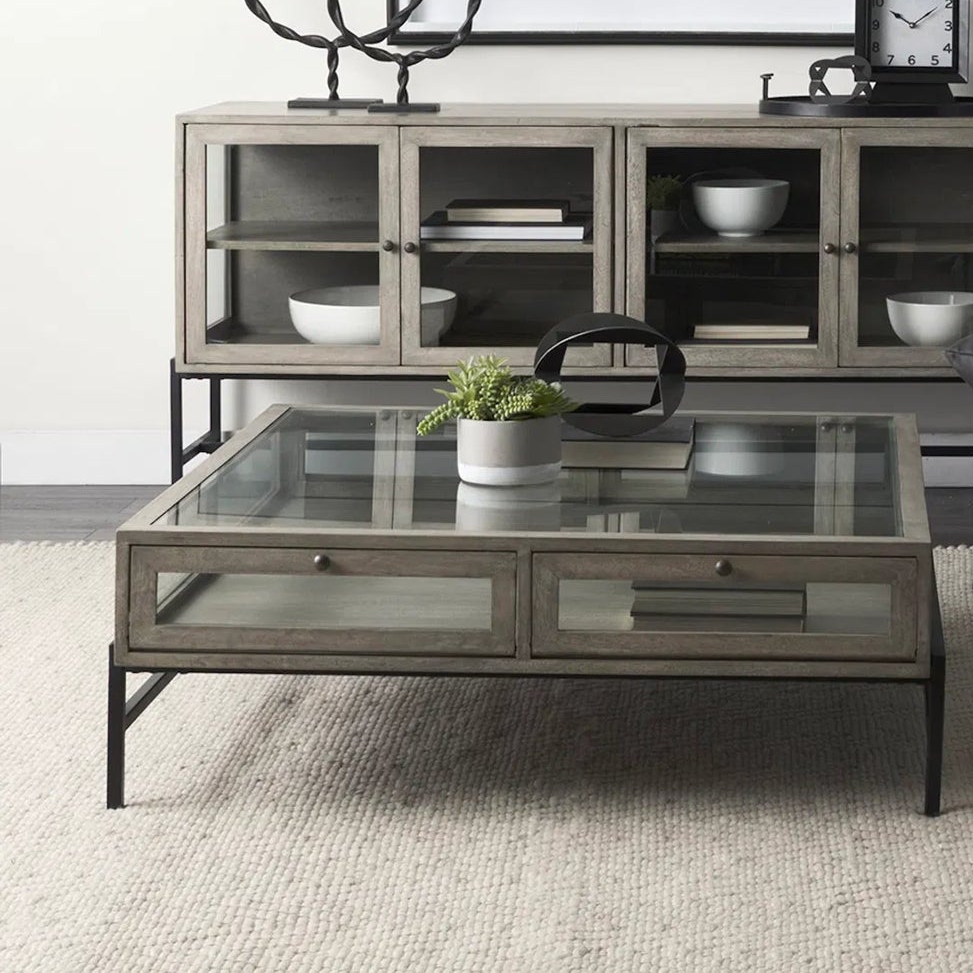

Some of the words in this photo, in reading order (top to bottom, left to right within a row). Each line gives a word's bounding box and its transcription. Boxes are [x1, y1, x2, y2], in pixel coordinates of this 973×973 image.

[872, 19, 880, 31] 9
[945, 20, 953, 32] 3
[872, 42, 880, 53] 8
[942, 43, 953, 54] 4
[887, 55, 895, 65] 7
[908, 55, 916, 66] 6
[931, 55, 939, 66] 5
